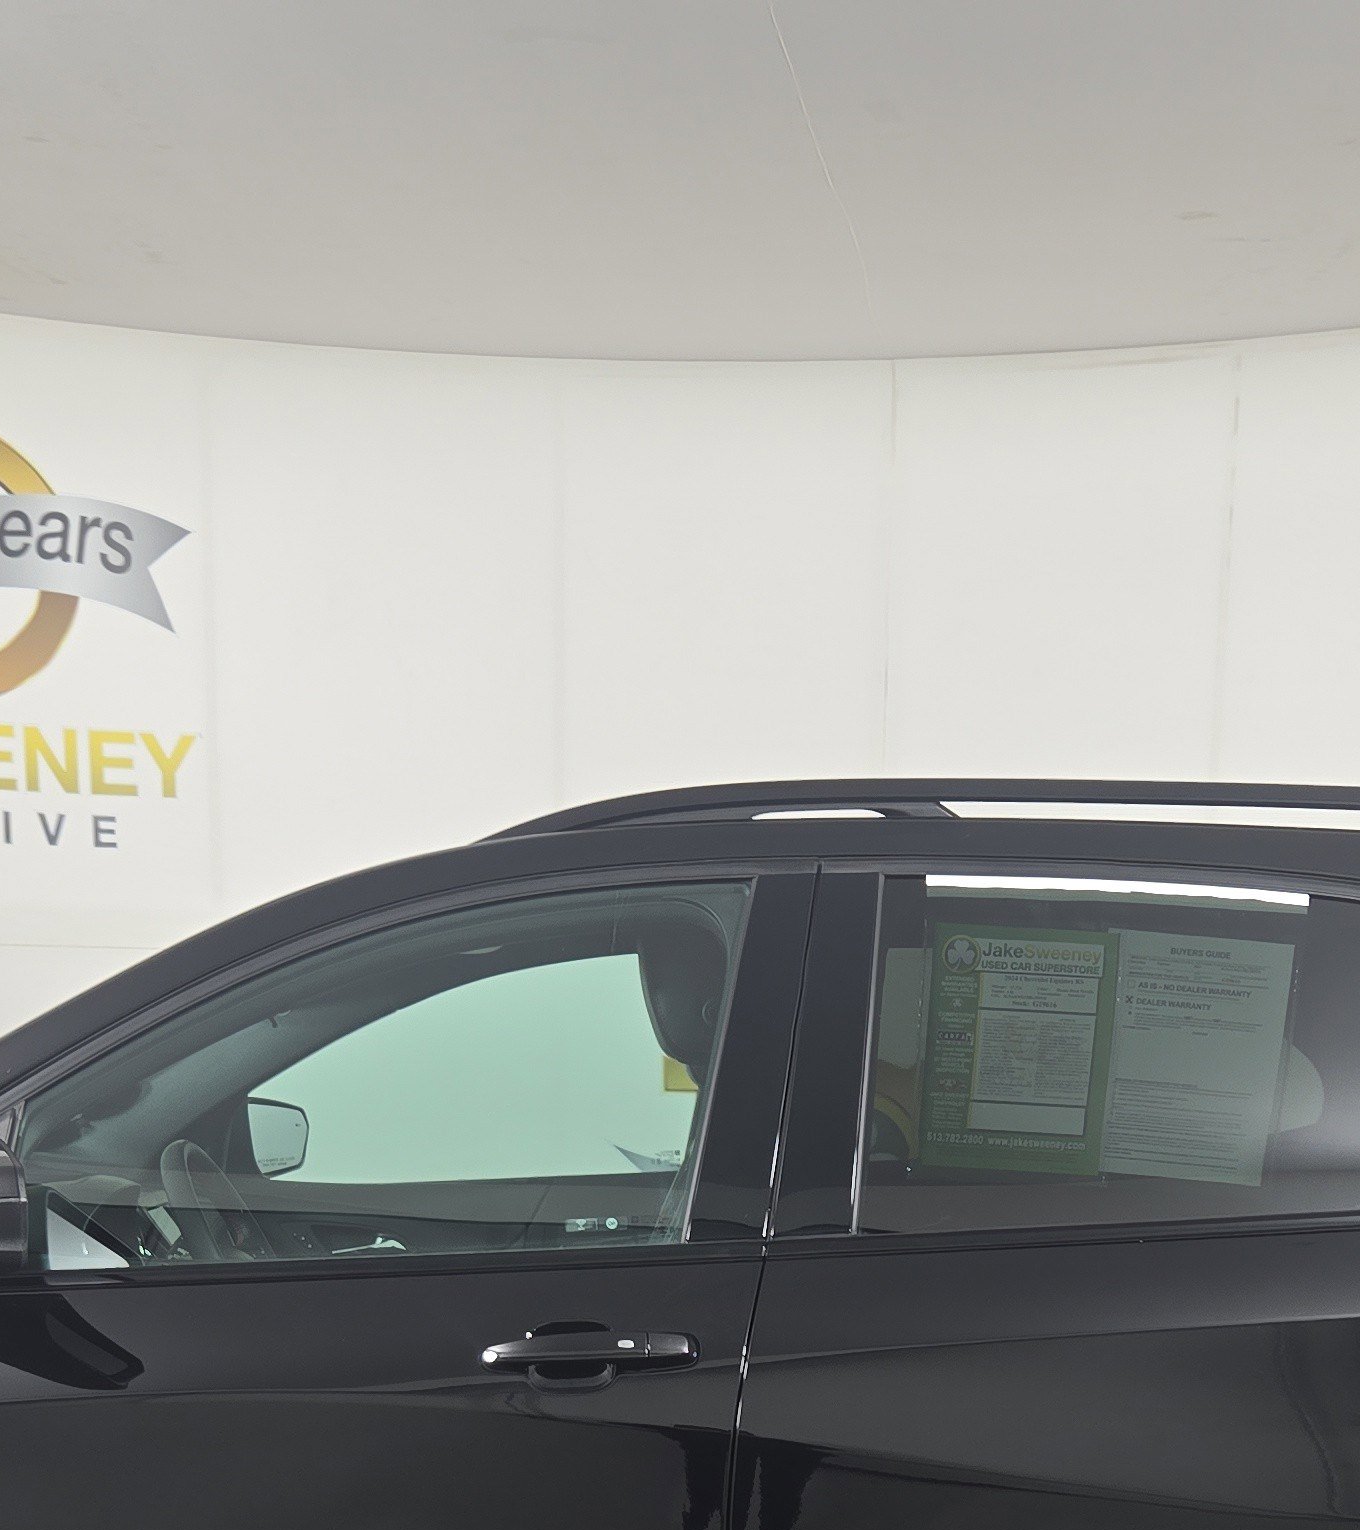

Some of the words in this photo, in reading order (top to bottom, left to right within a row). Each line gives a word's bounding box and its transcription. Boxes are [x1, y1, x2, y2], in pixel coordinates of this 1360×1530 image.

[1170, 947, 1204, 957] BUYERS
[1205, 950, 1232, 960] GUIDE
[981, 961, 1009, 971] USED
[1010, 962, 1032, 972] CAR
[1033, 963, 1100, 975] SUPERSTORE
[1176, 985, 1207, 994] DEALER
[1208, 988, 1252, 998] WARRANTY
[1136, 997, 1167, 1007] DEALER
[1168, 1000, 1212, 1011] WARRANTY
